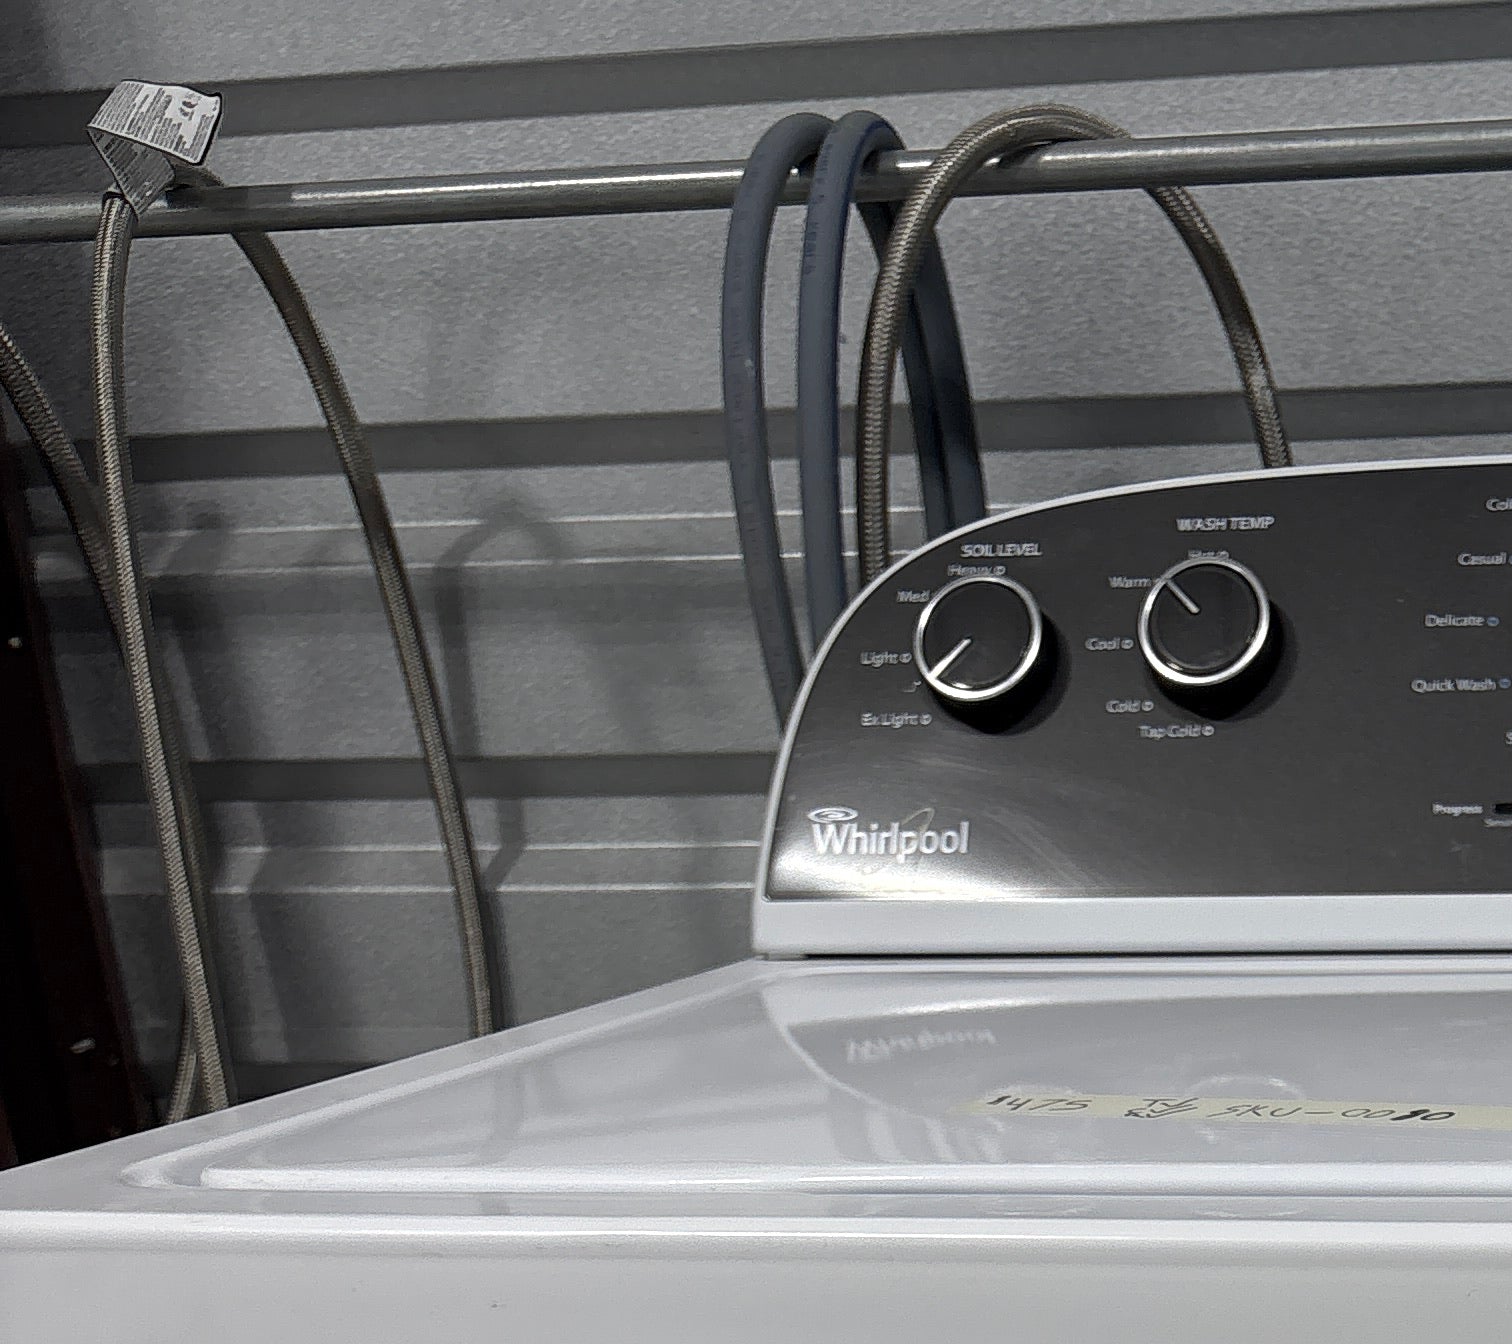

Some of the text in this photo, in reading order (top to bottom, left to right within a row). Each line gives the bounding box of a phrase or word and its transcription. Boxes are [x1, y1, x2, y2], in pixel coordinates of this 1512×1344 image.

[1177, 516, 1275, 532] WASH TEMP
[960, 543, 1042, 558] SOIL LEVEL
[1458, 553, 1507, 566] Casual
[1424, 614, 1485, 628] Delicate
[1085, 638, 1121, 651] Cool
[860, 652, 899, 668] Light
[1411, 679, 1497, 693] Quick Wash
[1105, 701, 1140, 713] Cold
[880, 712, 919, 729] Light
[1167, 725, 1200, 738] Cold
[1432, 803, 1483, 816] Progress
[812, 822, 970, 863] Whirlpool
